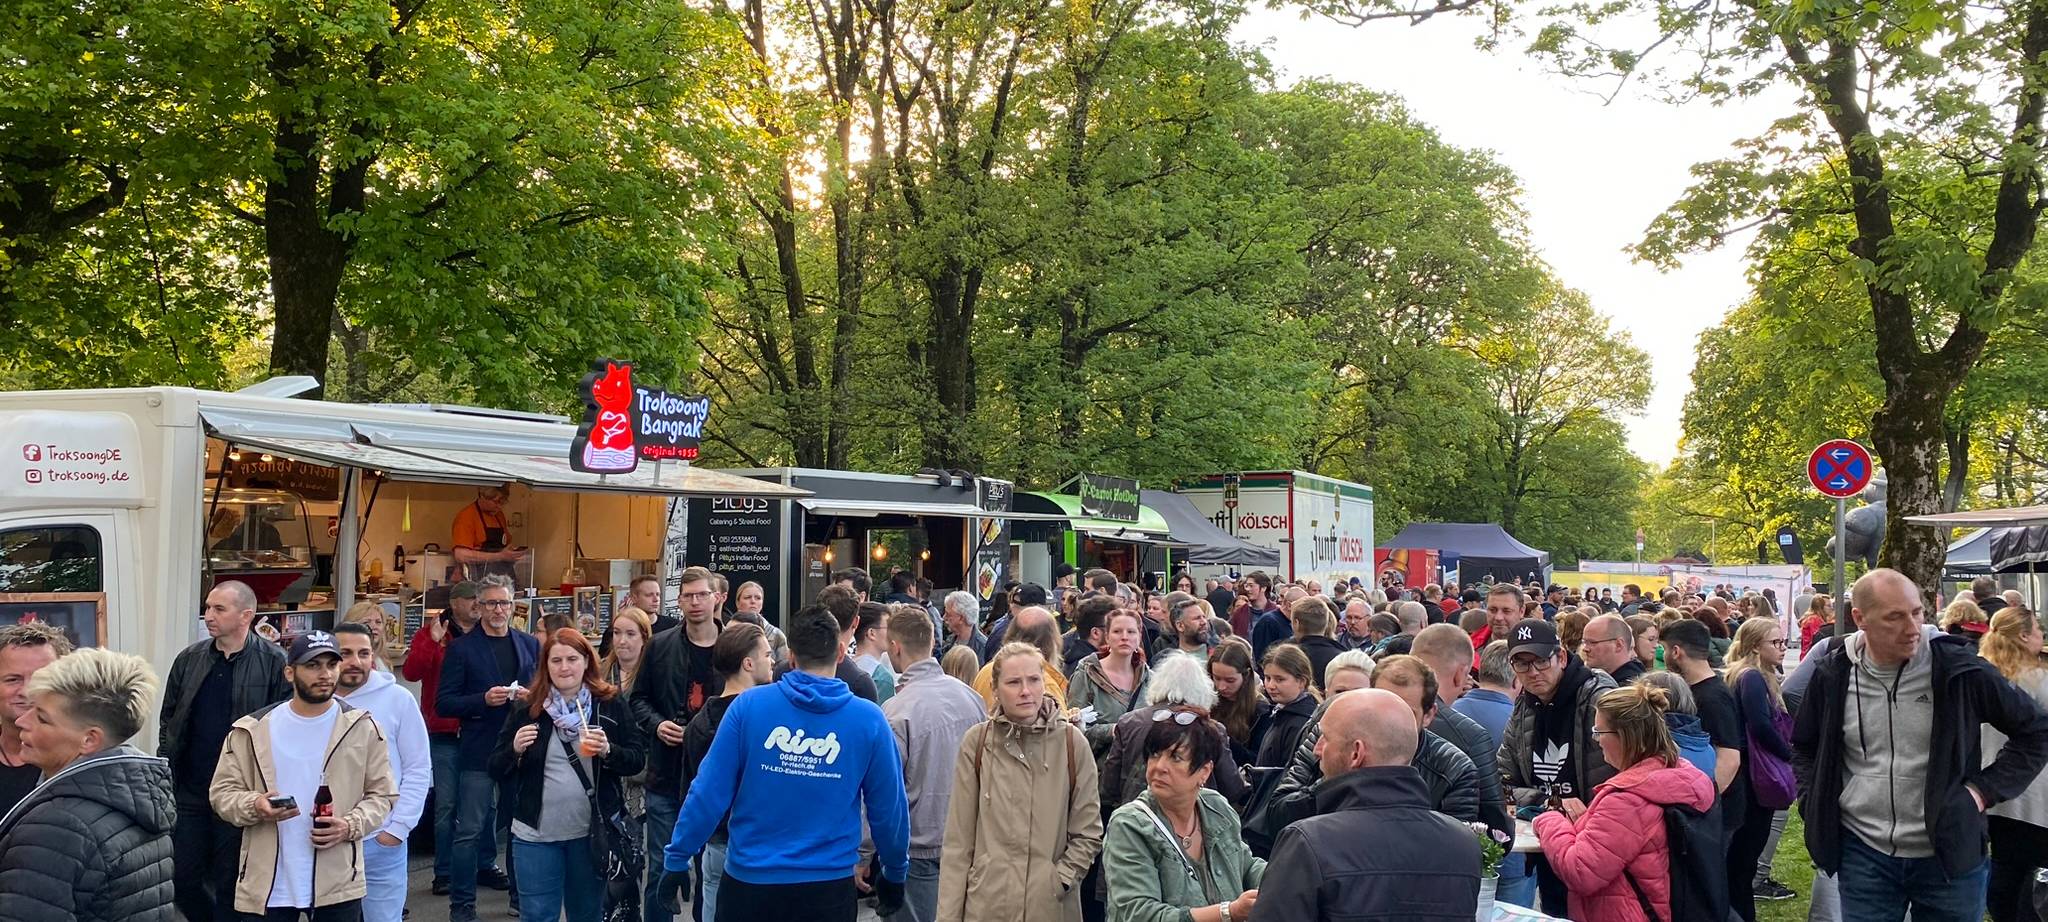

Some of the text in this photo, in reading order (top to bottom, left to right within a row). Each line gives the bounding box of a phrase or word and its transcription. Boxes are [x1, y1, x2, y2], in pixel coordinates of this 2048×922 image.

[636, 388, 709, 421] Troksoong
[641, 413, 703, 444] Bangrak
[47, 445, 122, 465] TroksoongDE
[643, 445, 676, 459] Original
[48, 468, 130, 485] troksoong.de
[709, 518, 733, 527] Catering
[738, 518, 756, 526] Street
[756, 518, 772, 526] Food
[1238, 512, 1288, 530] KÖLSCH
[1339, 530, 1363, 563] KÖLSCH
[764, 726, 841, 765] Risch
